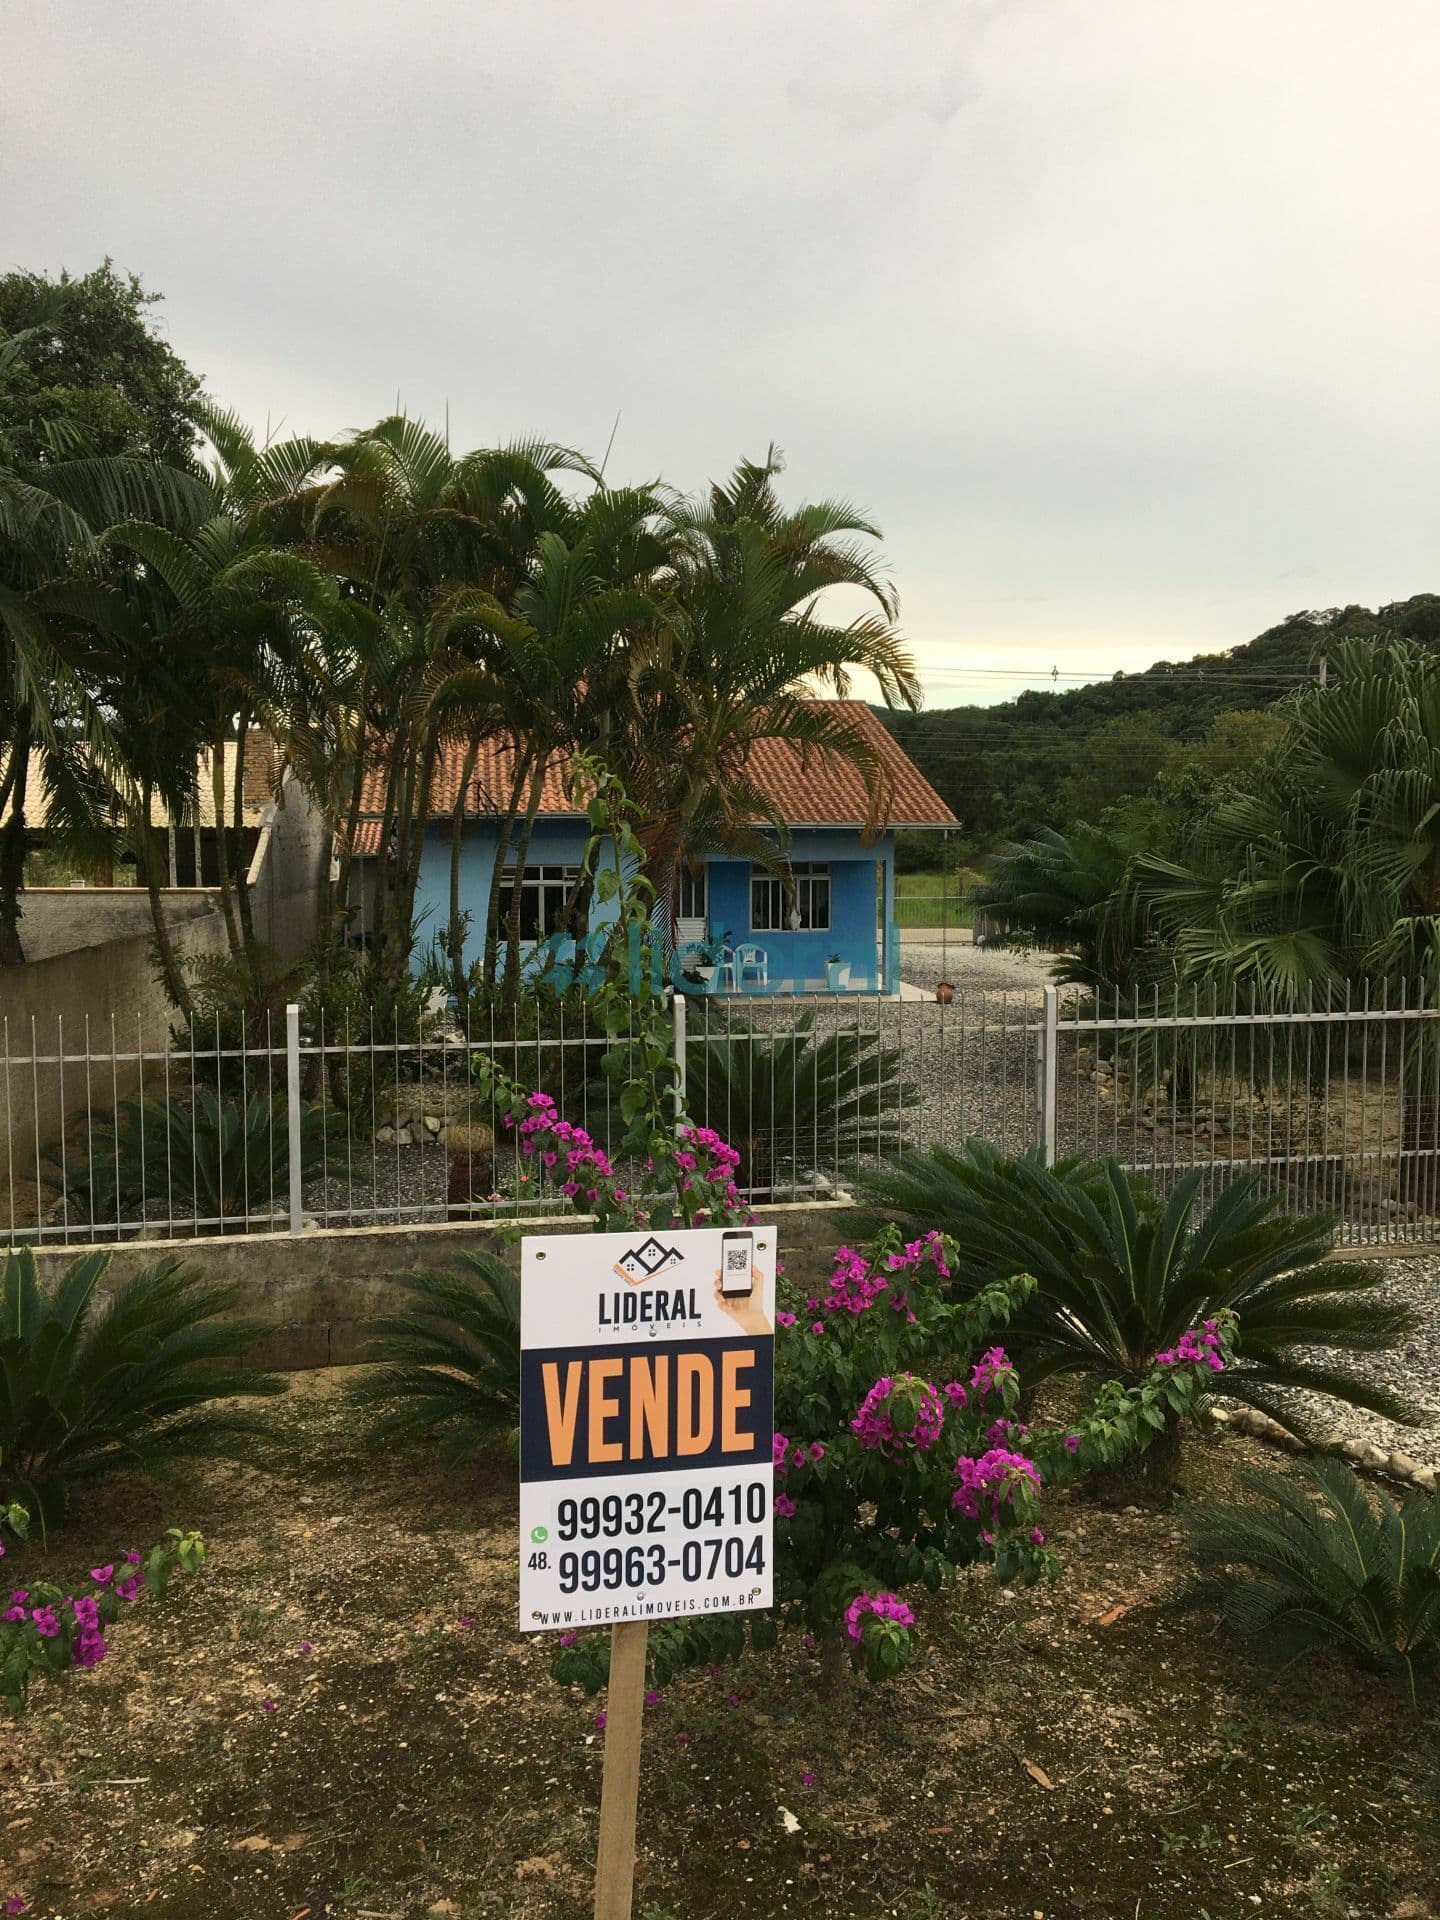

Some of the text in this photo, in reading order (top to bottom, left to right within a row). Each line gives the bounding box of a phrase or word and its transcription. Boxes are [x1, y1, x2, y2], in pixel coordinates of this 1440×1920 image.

[598, 1288, 702, 1324] LIDERAL
[541, 1350, 756, 1466] VENDE
[557, 1482, 766, 1541] 99932-0410
[527, 1535, 766, 1594] 48. 99963-0704
[540, 1593, 754, 1625] WWW.LIDERALIMOVEIS.COM.BR
